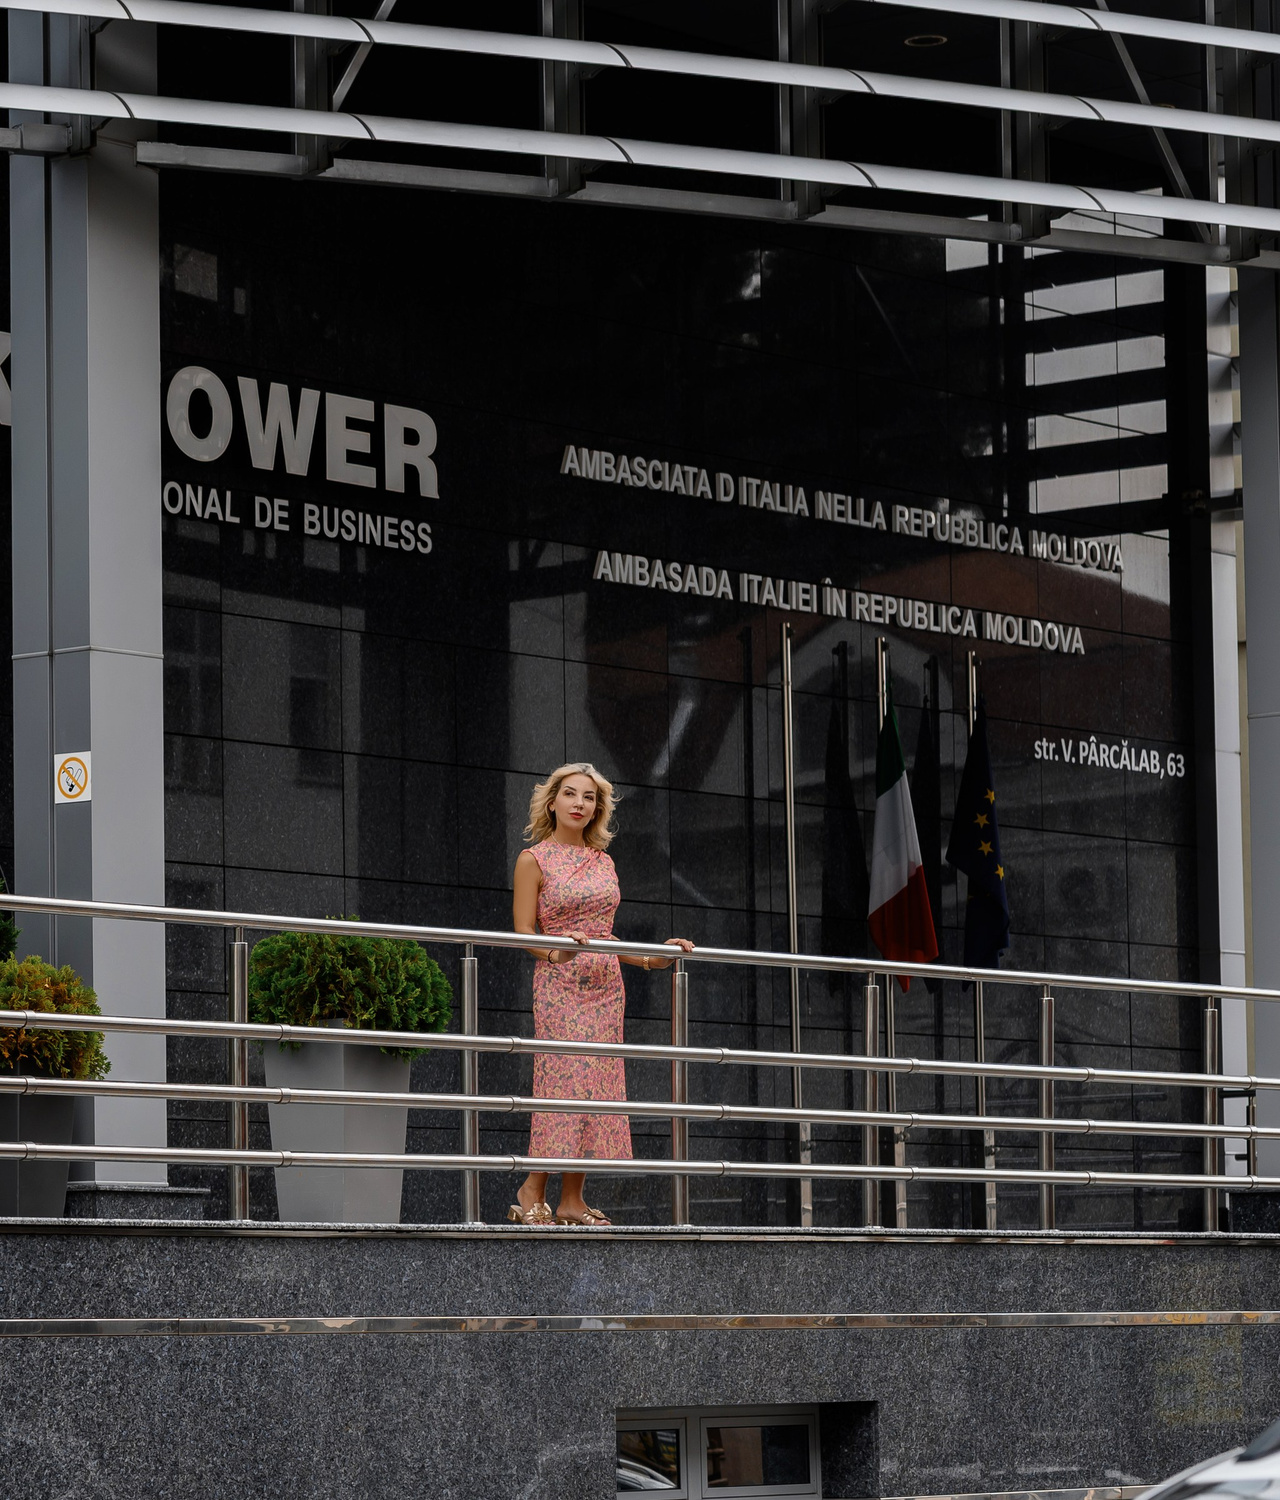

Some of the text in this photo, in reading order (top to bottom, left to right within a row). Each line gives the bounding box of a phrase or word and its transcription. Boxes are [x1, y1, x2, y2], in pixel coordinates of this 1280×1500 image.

[165, 364, 440, 500] OWER
[162, 480, 241, 525] ONAL
[254, 495, 290, 532] DE
[303, 502, 434, 555] BUSINESS
[559, 444, 713, 500] AMBASCIATA
[738, 475, 810, 517] ITALIA
[814, 490, 888, 531] NELLA
[891, 504, 1025, 556] REPUBBLICA
[1028, 529, 1125, 573] MOLDOVA
[592, 550, 1086, 655] AMBASADA ITALIEI ÎN REPUBLICA MOLDOVA
[1033, 735, 1186, 780] str. V. PÂRCĂLAB, 63
